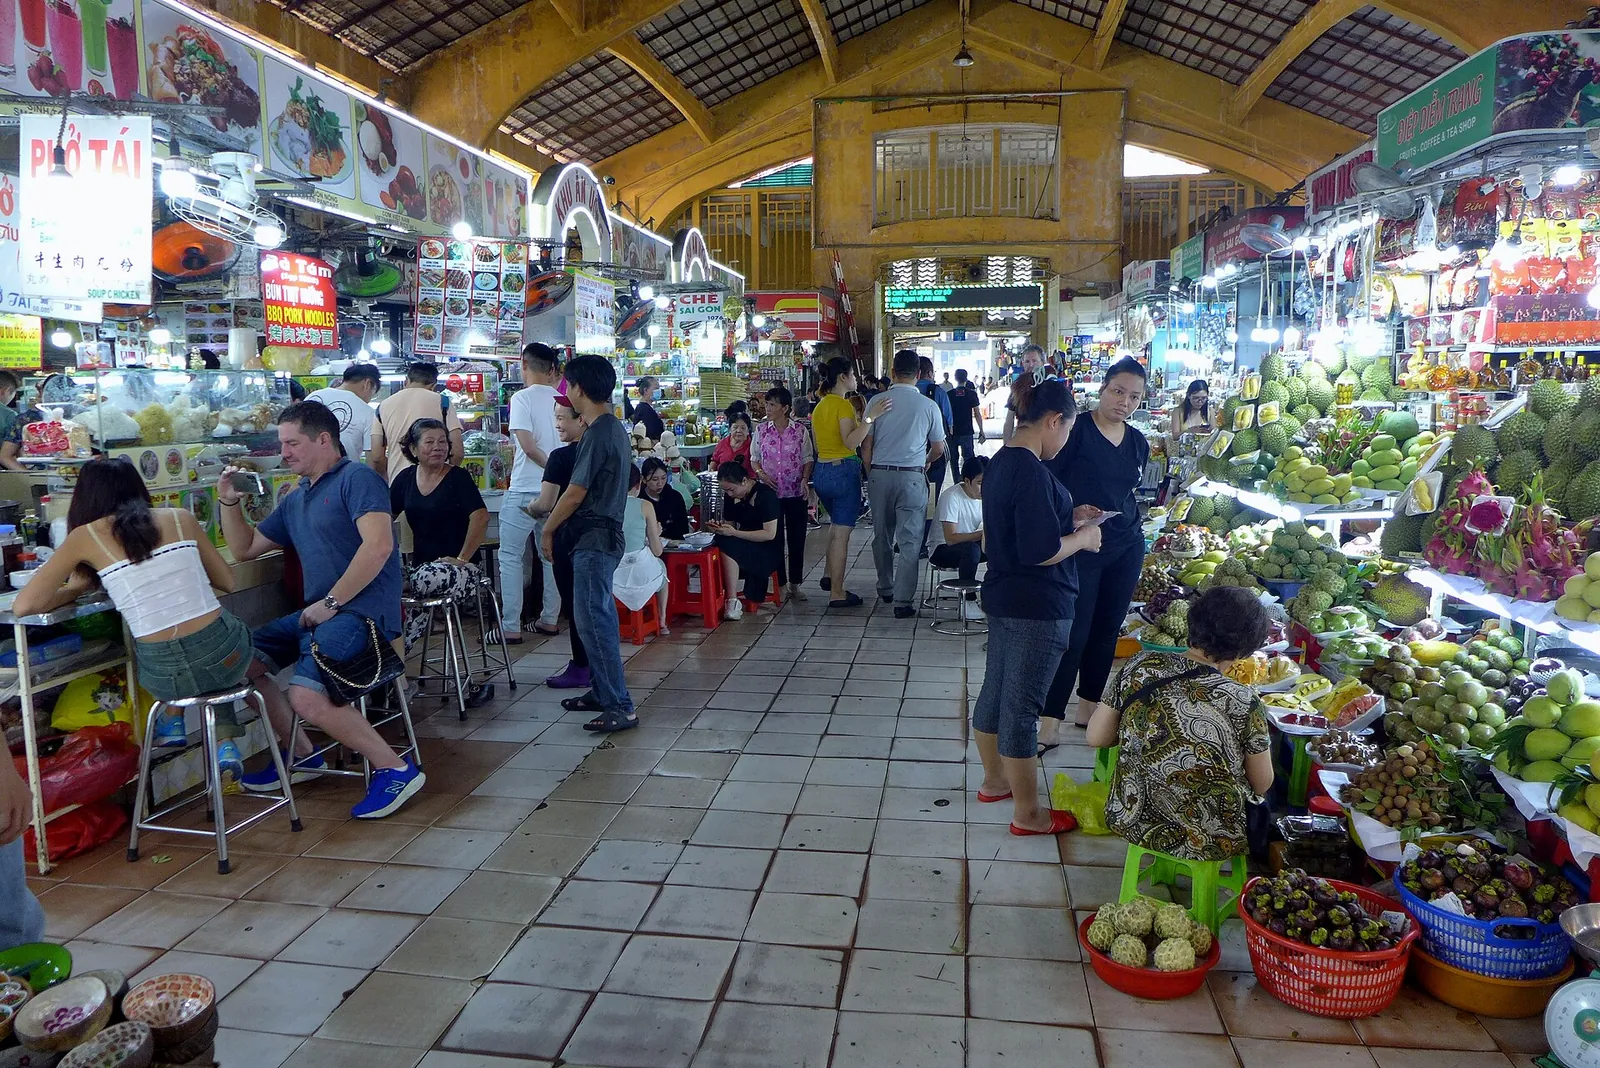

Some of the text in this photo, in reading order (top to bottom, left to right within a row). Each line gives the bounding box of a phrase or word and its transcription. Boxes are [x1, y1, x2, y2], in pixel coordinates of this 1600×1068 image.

[1447, 73, 1484, 119] TRANG
[88, 126, 142, 179] TÁI
[1399, 146, 1417, 161] FRUITS
[1420, 133, 1441, 152] COFFEE
[1446, 126, 1458, 140] TEA
[1459, 116, 1477, 136] SHOP
[555, 178, 573, 227] KHU
[575, 171, 586, 204] ĂN
[295, 258, 332, 278] Tám
[87, 288, 107, 299] SOUP
[265, 279, 282, 301] BÚN
[266, 305, 335, 328] BBQ PORK NOODLES
